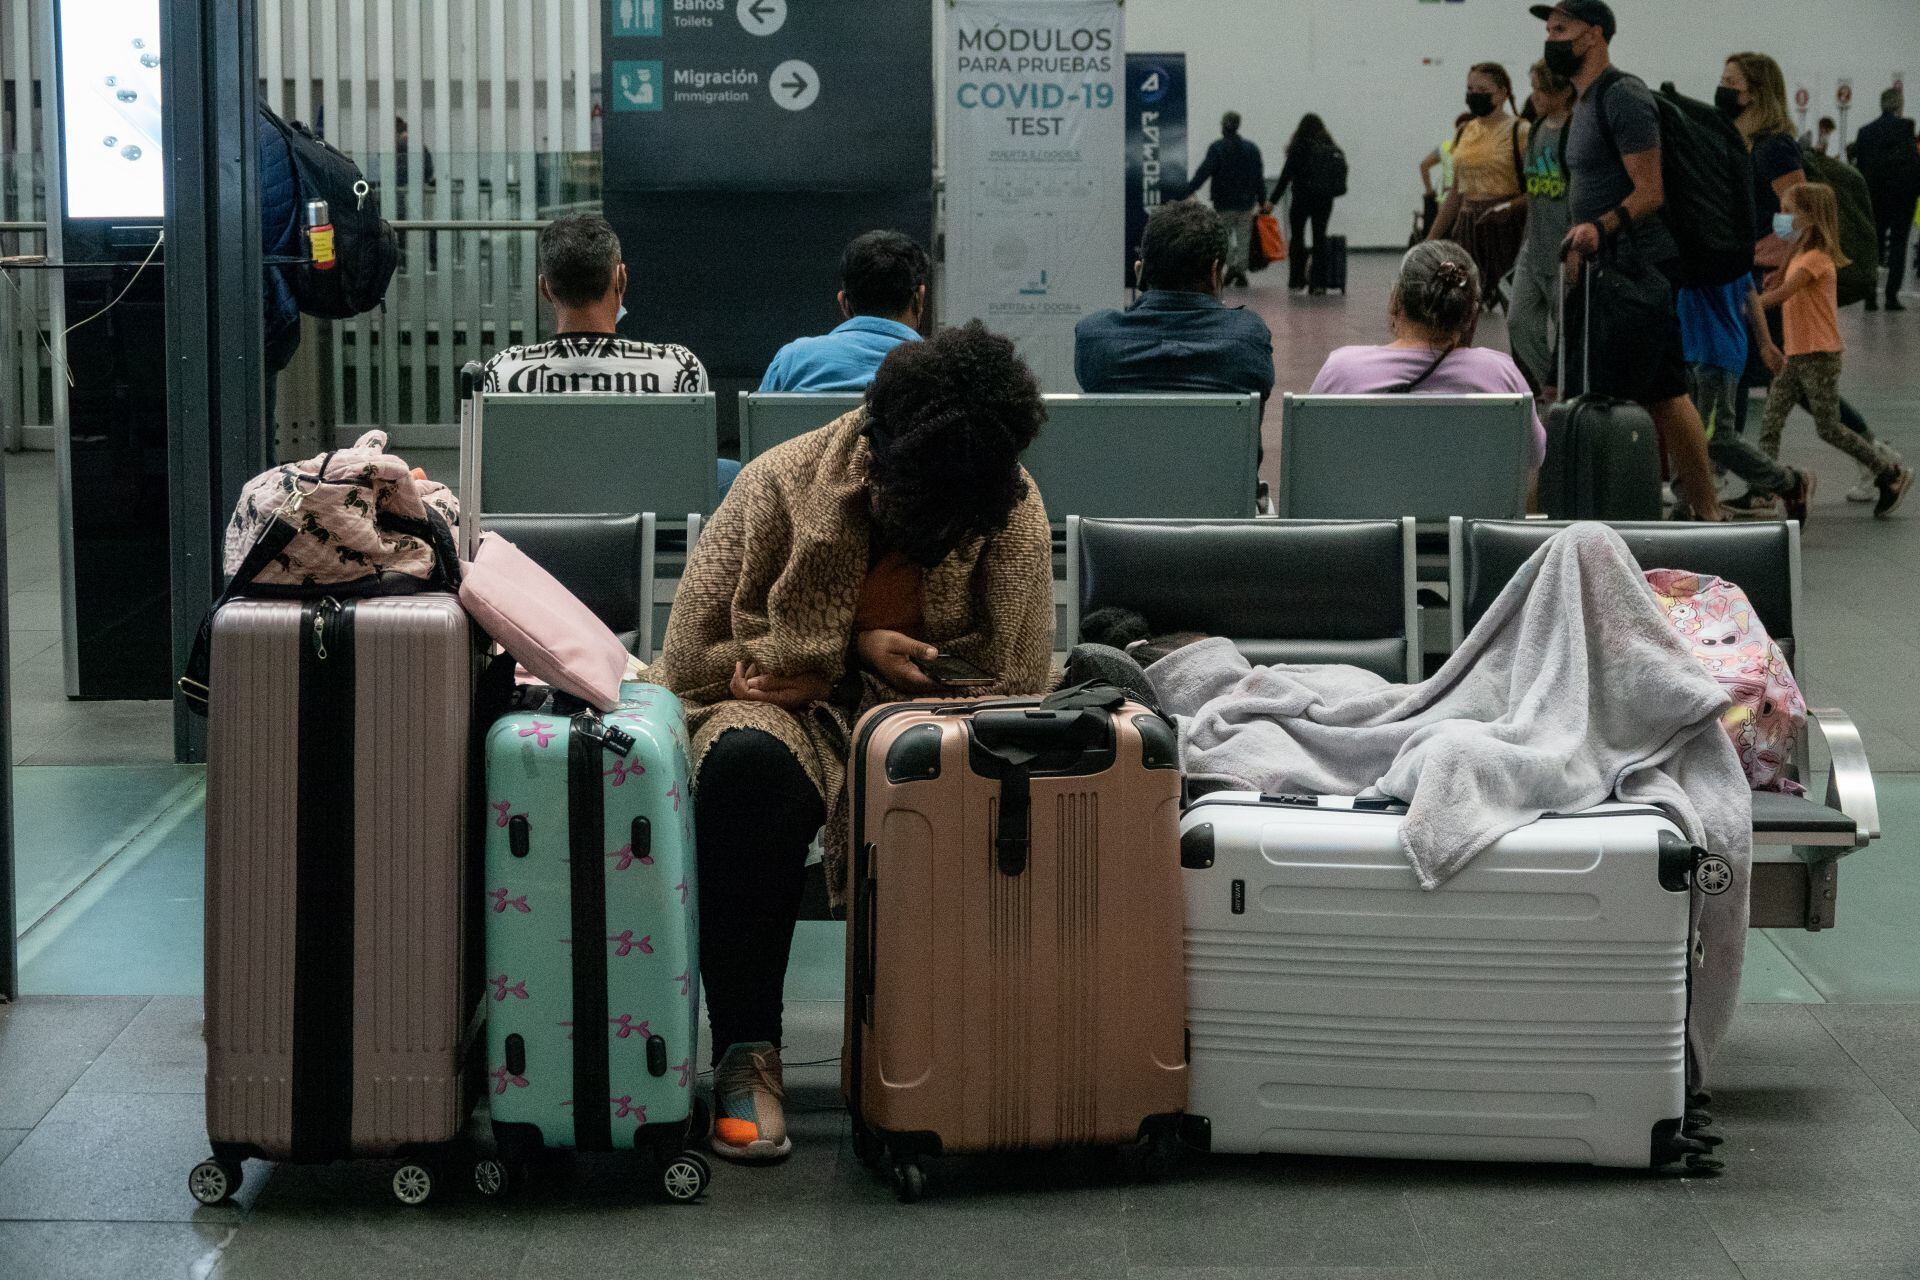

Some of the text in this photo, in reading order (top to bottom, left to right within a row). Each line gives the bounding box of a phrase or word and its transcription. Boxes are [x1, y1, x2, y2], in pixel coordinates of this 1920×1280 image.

[674, 15, 713, 27] Toilets
[958, 24, 1112, 51] MÓDULOS
[958, 57, 1111, 72] PARA PRUEBAS
[674, 68, 759, 88] Migración
[674, 90, 749, 104] Immigration
[957, 82, 1114, 109] COVID-19
[1006, 117, 1064, 135] TEST
[508, 363, 661, 393] Corona
